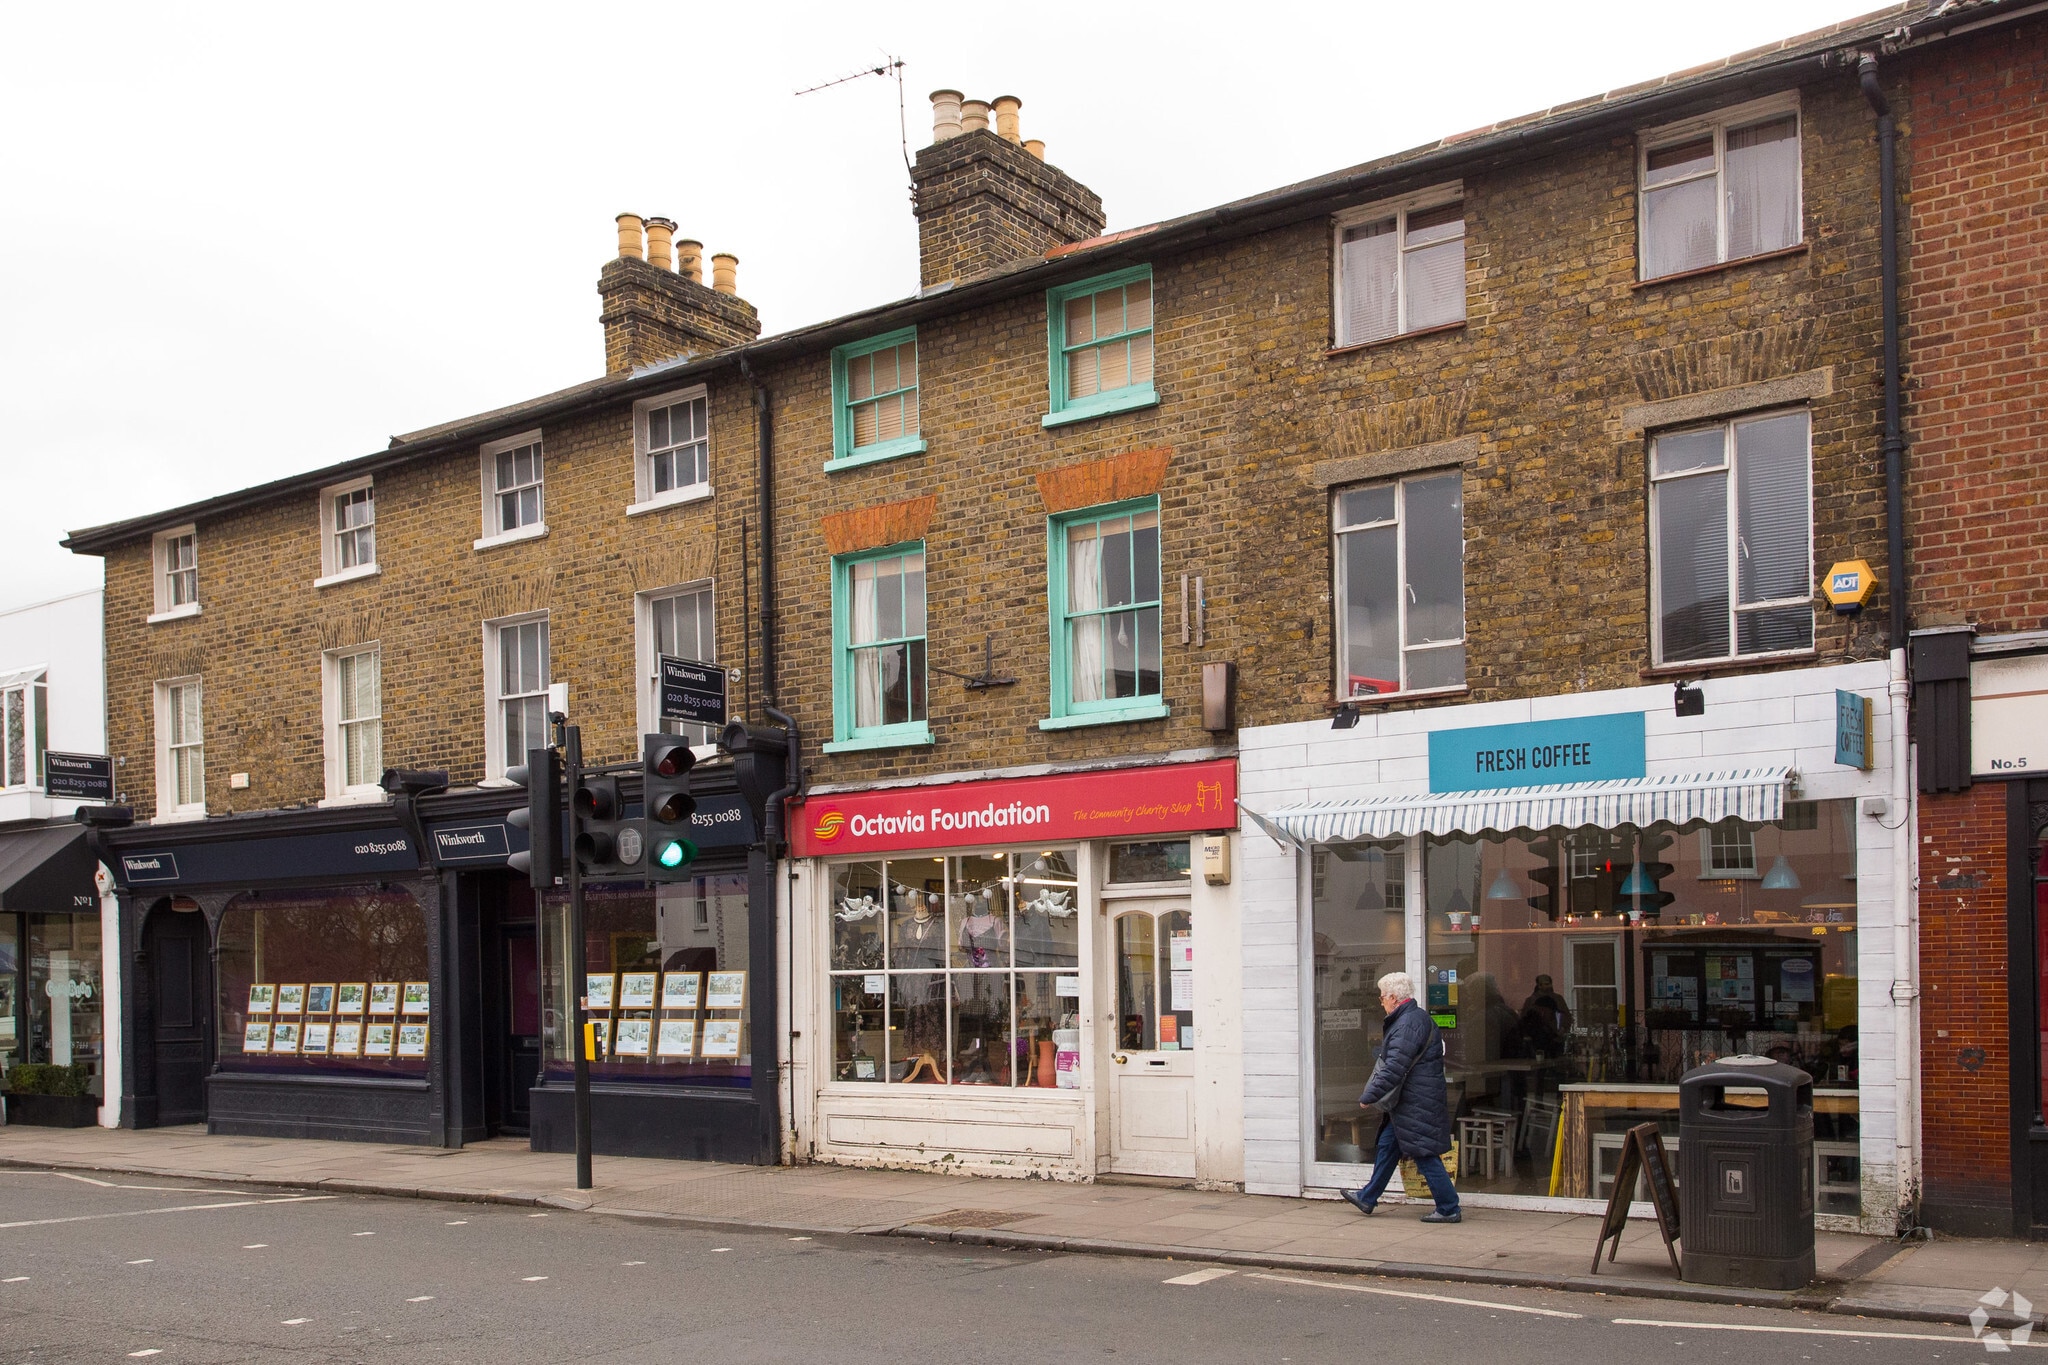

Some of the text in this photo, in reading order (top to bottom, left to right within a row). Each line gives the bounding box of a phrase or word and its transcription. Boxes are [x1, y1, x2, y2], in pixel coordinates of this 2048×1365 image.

[1834, 576, 1859, 590] ADT
[666, 666, 707, 682] Winkworth
[667, 693, 721, 709] 020 8255 0088
[667, 708, 698, 717] winkworth.co.uk
[1840, 705, 1863, 733] FRESH
[1840, 731, 1863, 755] COFFEE
[51, 759, 92, 769] Winkworth
[1476, 742, 1591, 773] FRESH COFFEE
[1991, 757, 2027, 769] No.5
[69, 778, 86, 788] 8255
[87, 780, 108, 788] 0088
[691, 808, 741, 827] 8255 0088
[850, 801, 1050, 837] Octavia Foundation
[1073, 801, 1192, 822] The Community Charity Shop
[438, 832, 485, 846] Winkworth
[355, 840, 407, 855] 020 8255 0088
[125, 859, 161, 870] Winkworth
[618, 891, 629, 899] AND
